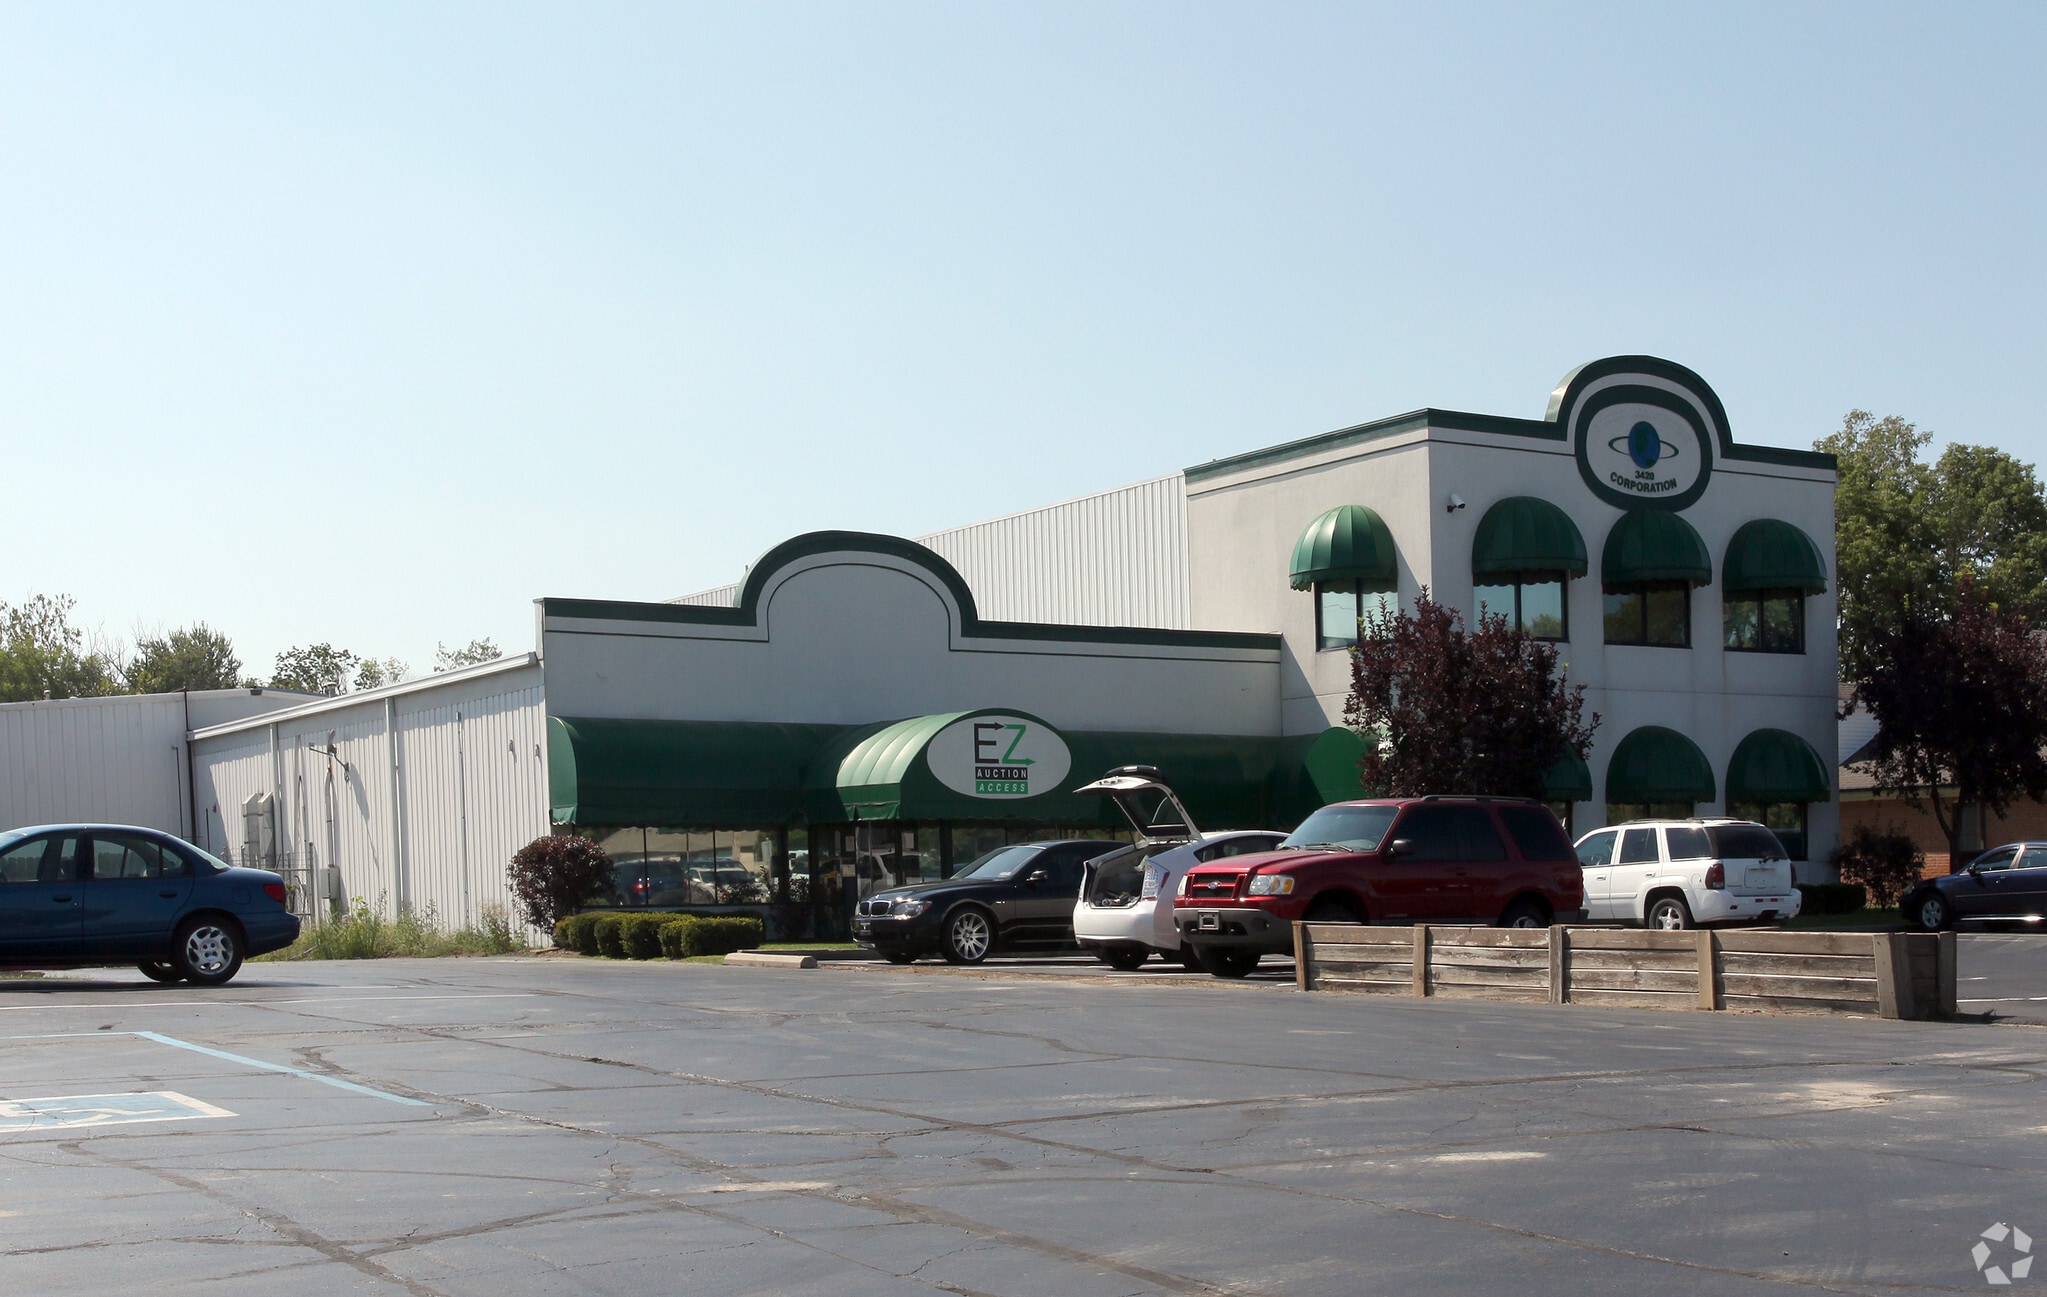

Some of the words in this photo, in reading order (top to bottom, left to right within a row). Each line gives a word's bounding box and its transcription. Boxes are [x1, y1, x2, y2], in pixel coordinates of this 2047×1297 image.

[1634, 470, 1655, 480] 3420
[1610, 471, 1678, 493] CORPORATION
[974, 722, 1036, 766] EZ
[976, 768, 1027, 778] AUCTION
[978, 783, 1026, 792] ACCESS
